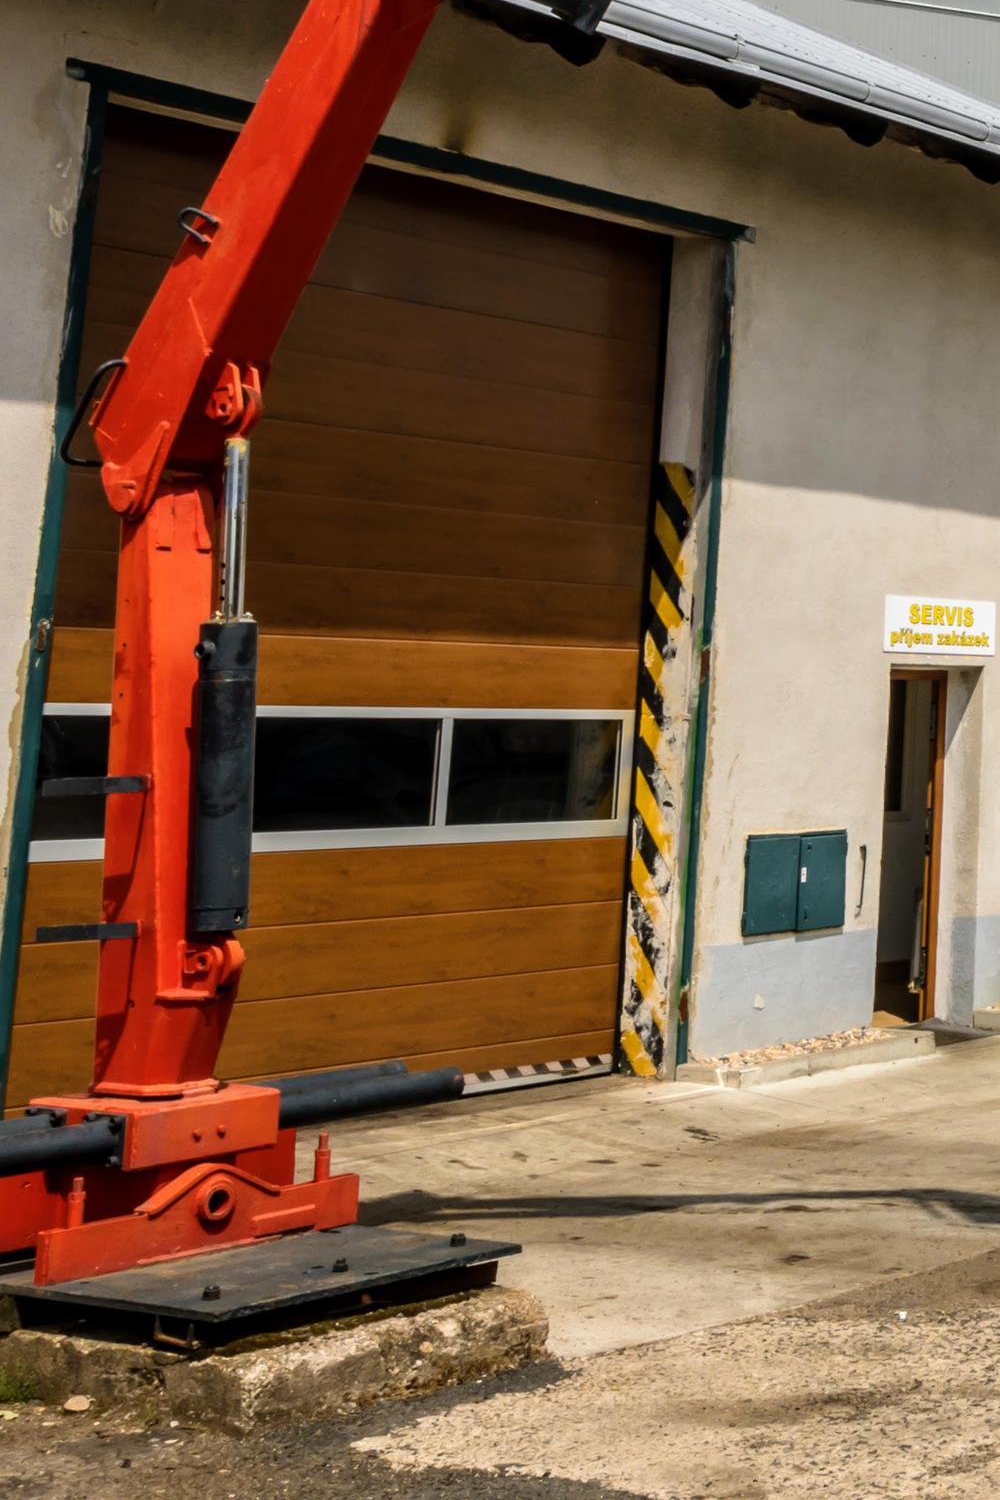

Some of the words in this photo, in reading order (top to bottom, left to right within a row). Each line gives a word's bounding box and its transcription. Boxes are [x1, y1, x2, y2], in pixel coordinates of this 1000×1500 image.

[909, 603, 974, 628] SERVIS
[890, 627, 933, 648] příjem
[937, 630, 990, 647] zakázek
